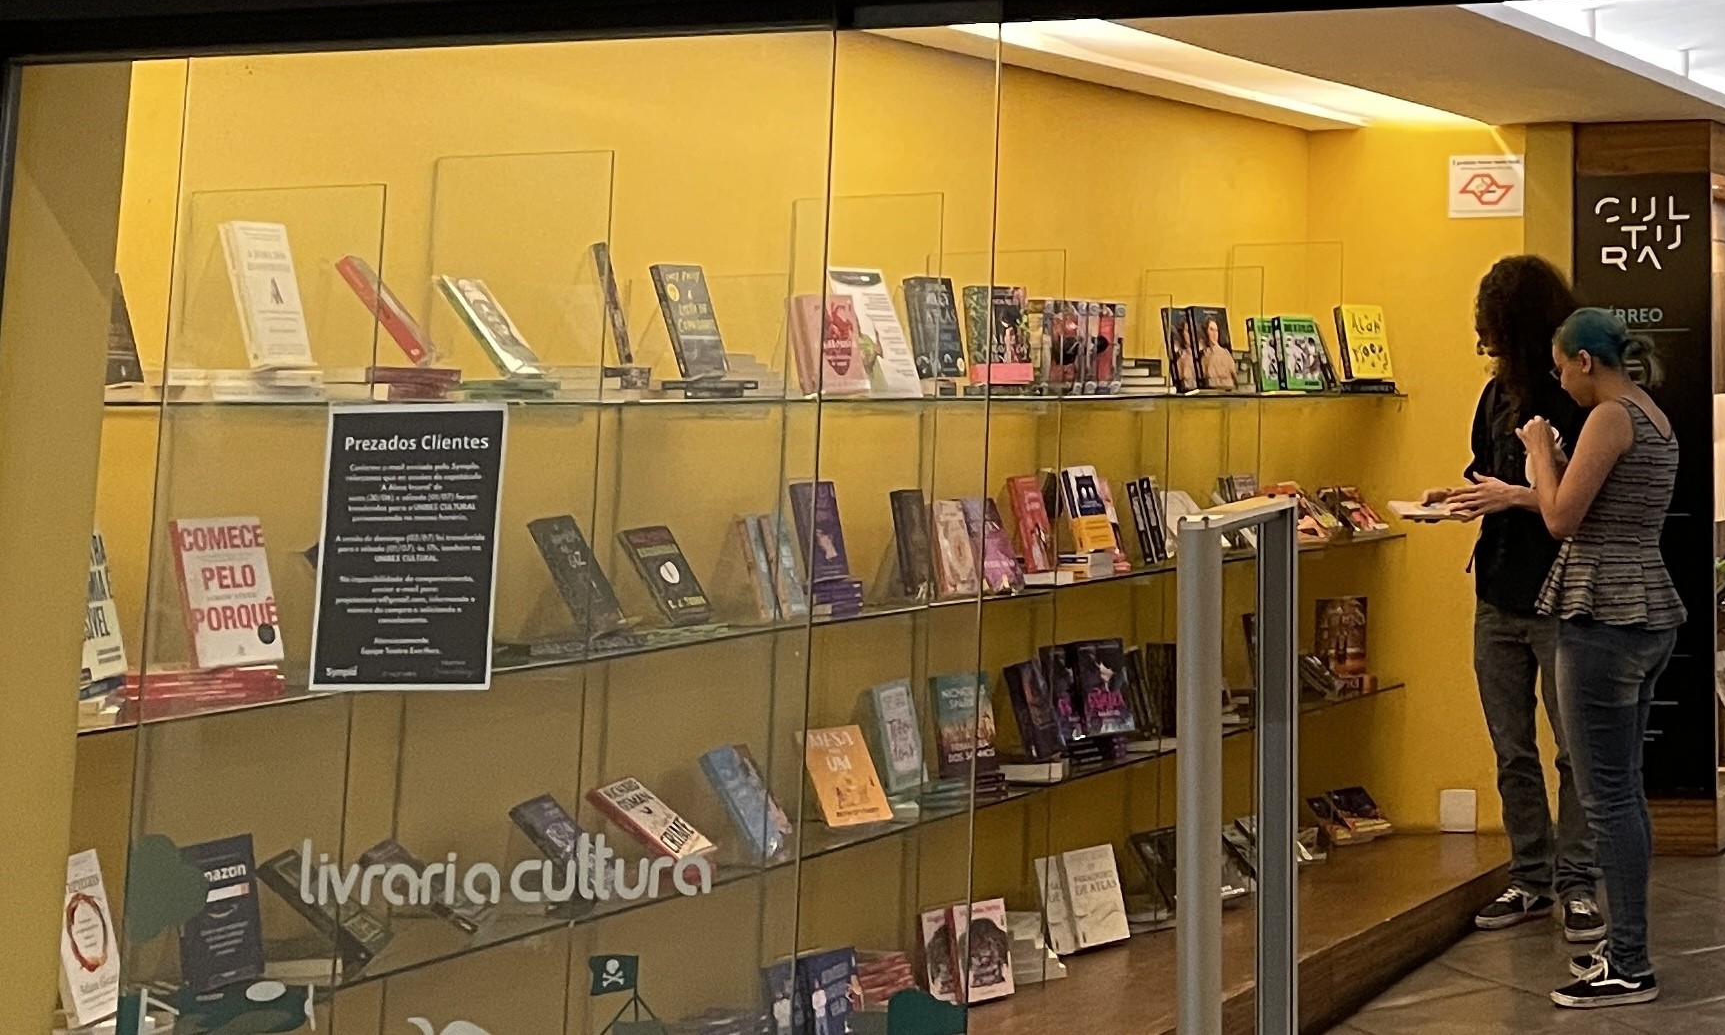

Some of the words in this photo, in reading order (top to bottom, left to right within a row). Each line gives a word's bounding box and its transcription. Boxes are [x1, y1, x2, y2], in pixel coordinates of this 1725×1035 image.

[1610, 306, 1663, 323] RREO
[345, 435, 416, 451] Prezados
[422, 434, 489, 449] Clientes
[179, 524, 264, 552] COMECE
[201, 564, 256, 590] PELO
[191, 596, 279, 633] PORQUÊ
[660, 817, 695, 854] CRIME
[204, 864, 246, 882] mazon
[300, 836, 501, 906] livraria
[510, 832, 712, 903] cultura
